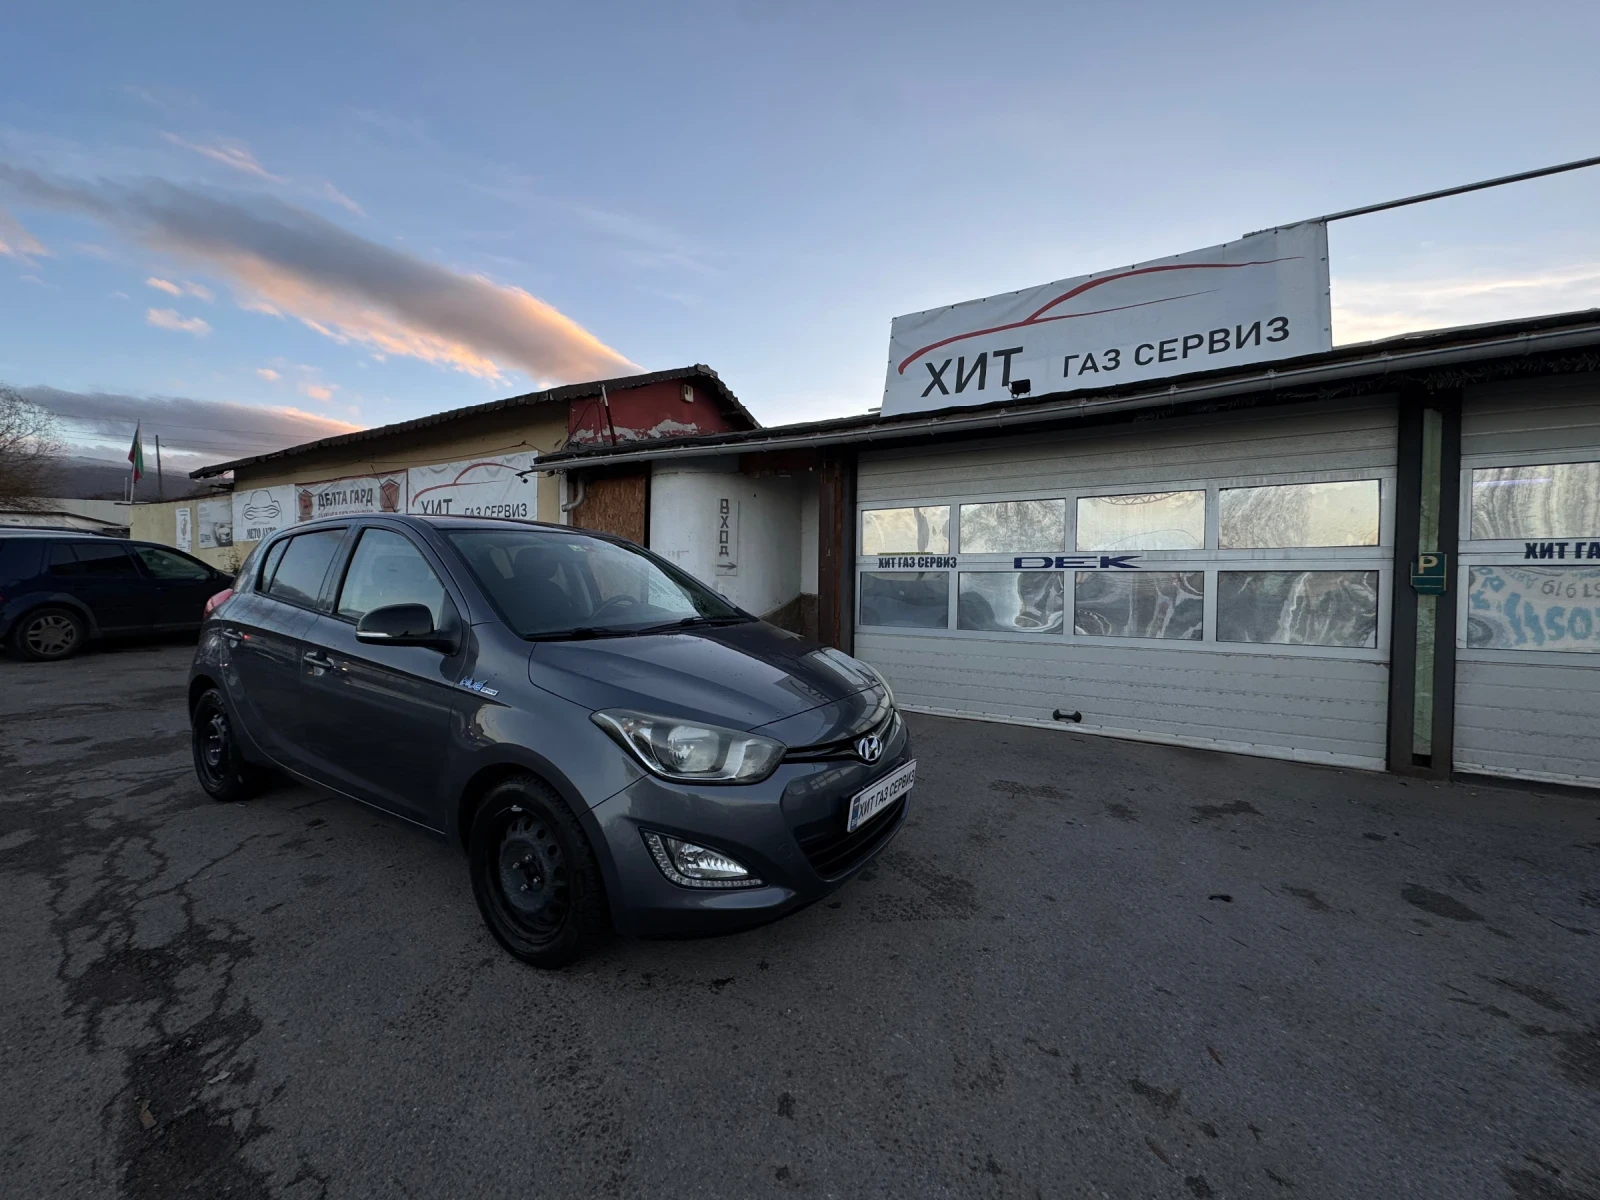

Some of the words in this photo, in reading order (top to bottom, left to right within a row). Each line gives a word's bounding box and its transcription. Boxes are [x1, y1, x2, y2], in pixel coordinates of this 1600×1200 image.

[920, 346, 1024, 398] ХИТ
[1063, 348, 1121, 378] ГАЗ
[1134, 316, 1290, 366] СЕРВИЗ
[318, 491, 348, 510] ДЕЛТА
[350, 488, 374, 506] ГАРД
[719, 498, 730, 557] ВХОД
[1524, 542, 1569, 560] ХИТ
[878, 557, 896, 569] ХИТ
[898, 557, 916, 569] ГАЗ
[917, 556, 957, 569] СЕРВИЗ
[1013, 555, 1142, 569] DEK
[1418, 555, 1438, 574] P
[858, 795, 875, 819] ХИТ
[875, 786, 889, 807] ГАЗ
[889, 769, 915, 797] СЕРВИЗ
